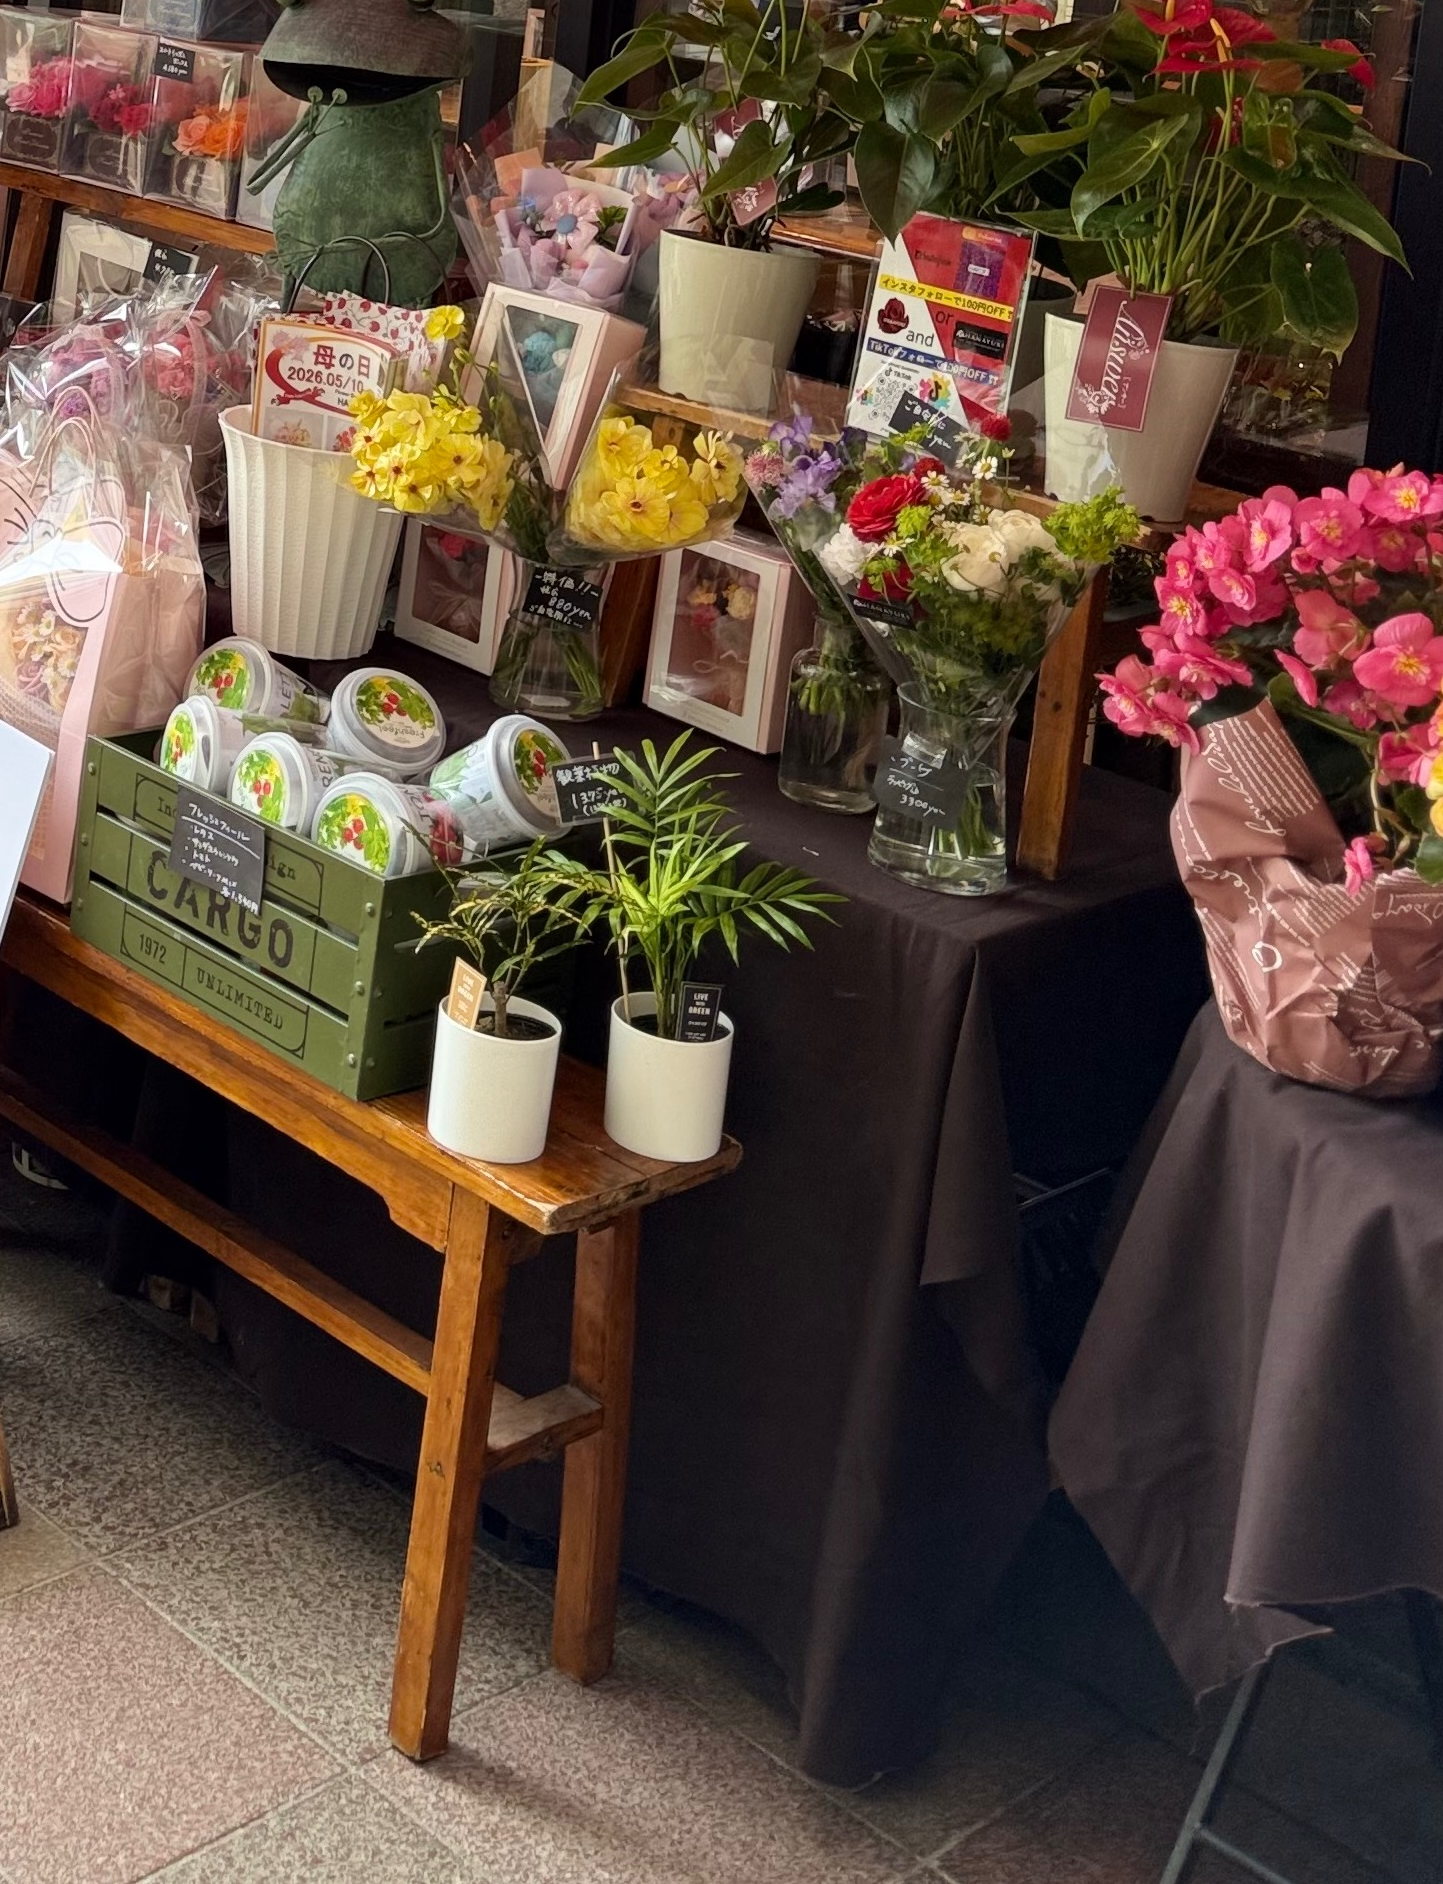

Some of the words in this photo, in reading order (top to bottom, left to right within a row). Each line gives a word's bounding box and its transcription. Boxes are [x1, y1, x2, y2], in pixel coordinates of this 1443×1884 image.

[935, 310, 955, 325] or
[906, 329, 935, 348] and
[313, 344, 371, 379] 母の日
[287, 366, 364, 394] 2026.05/10
[139, 932, 167, 965] 1972
[196, 967, 284, 1030] UNLIMITED
